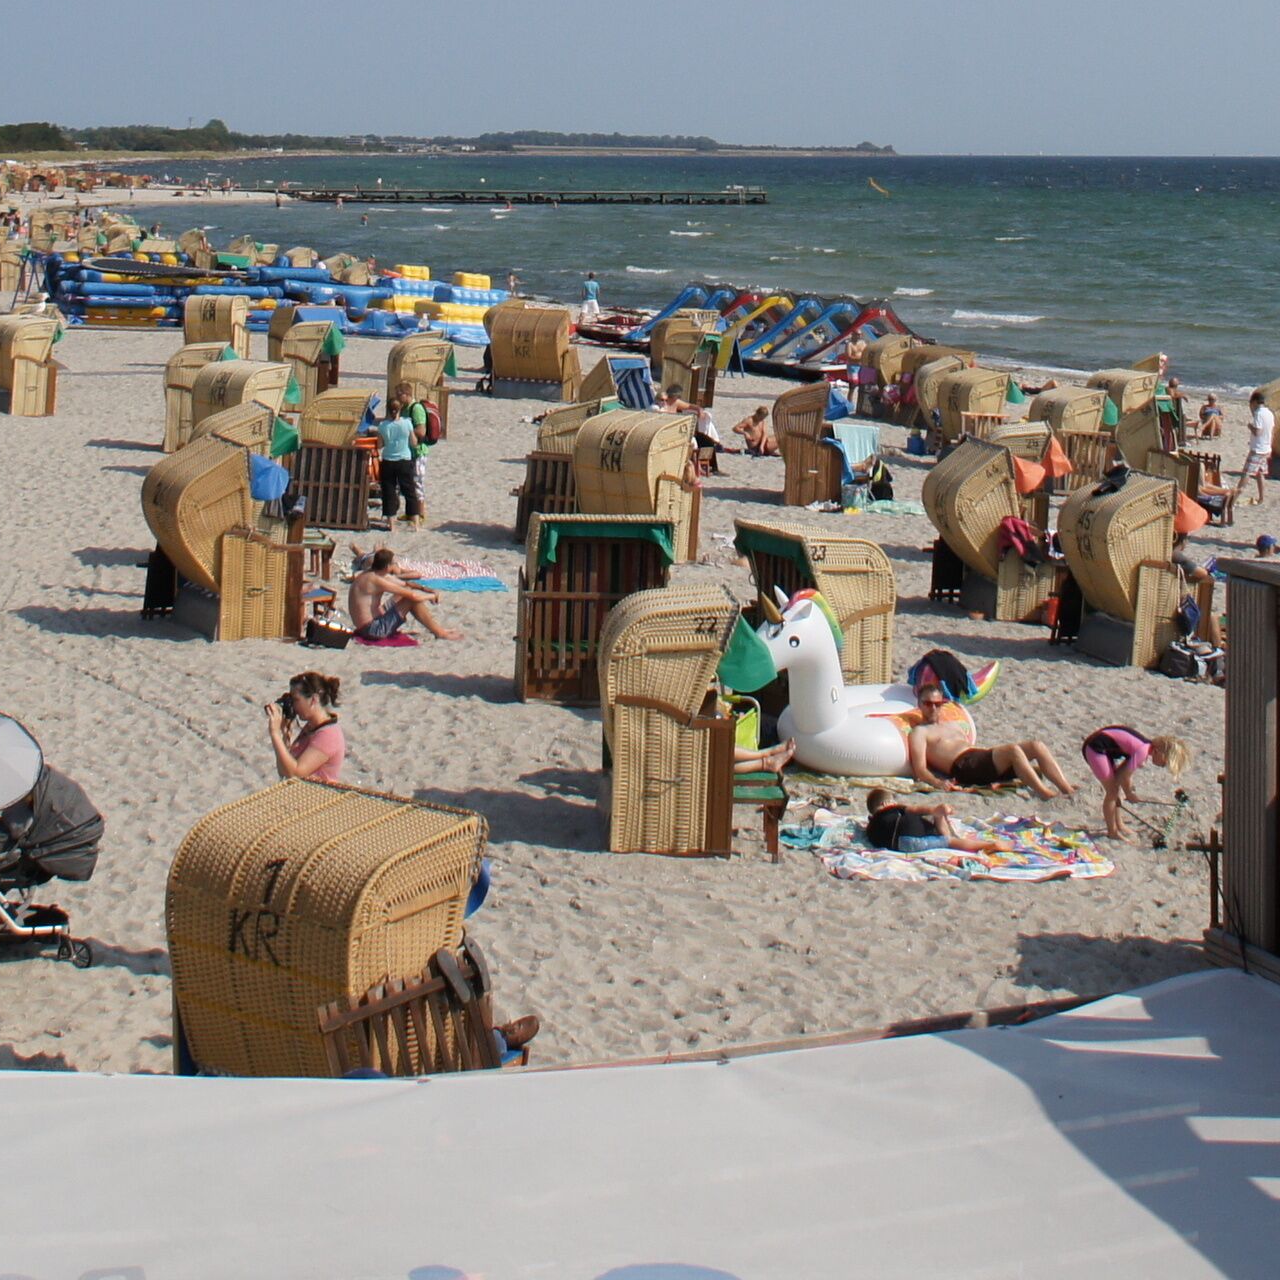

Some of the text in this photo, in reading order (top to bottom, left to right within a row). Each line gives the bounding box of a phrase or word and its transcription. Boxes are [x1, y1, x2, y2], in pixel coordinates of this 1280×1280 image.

[606, 431, 626, 447] 43
[694, 616, 718, 634] 22
[227, 907, 281, 967] KR
